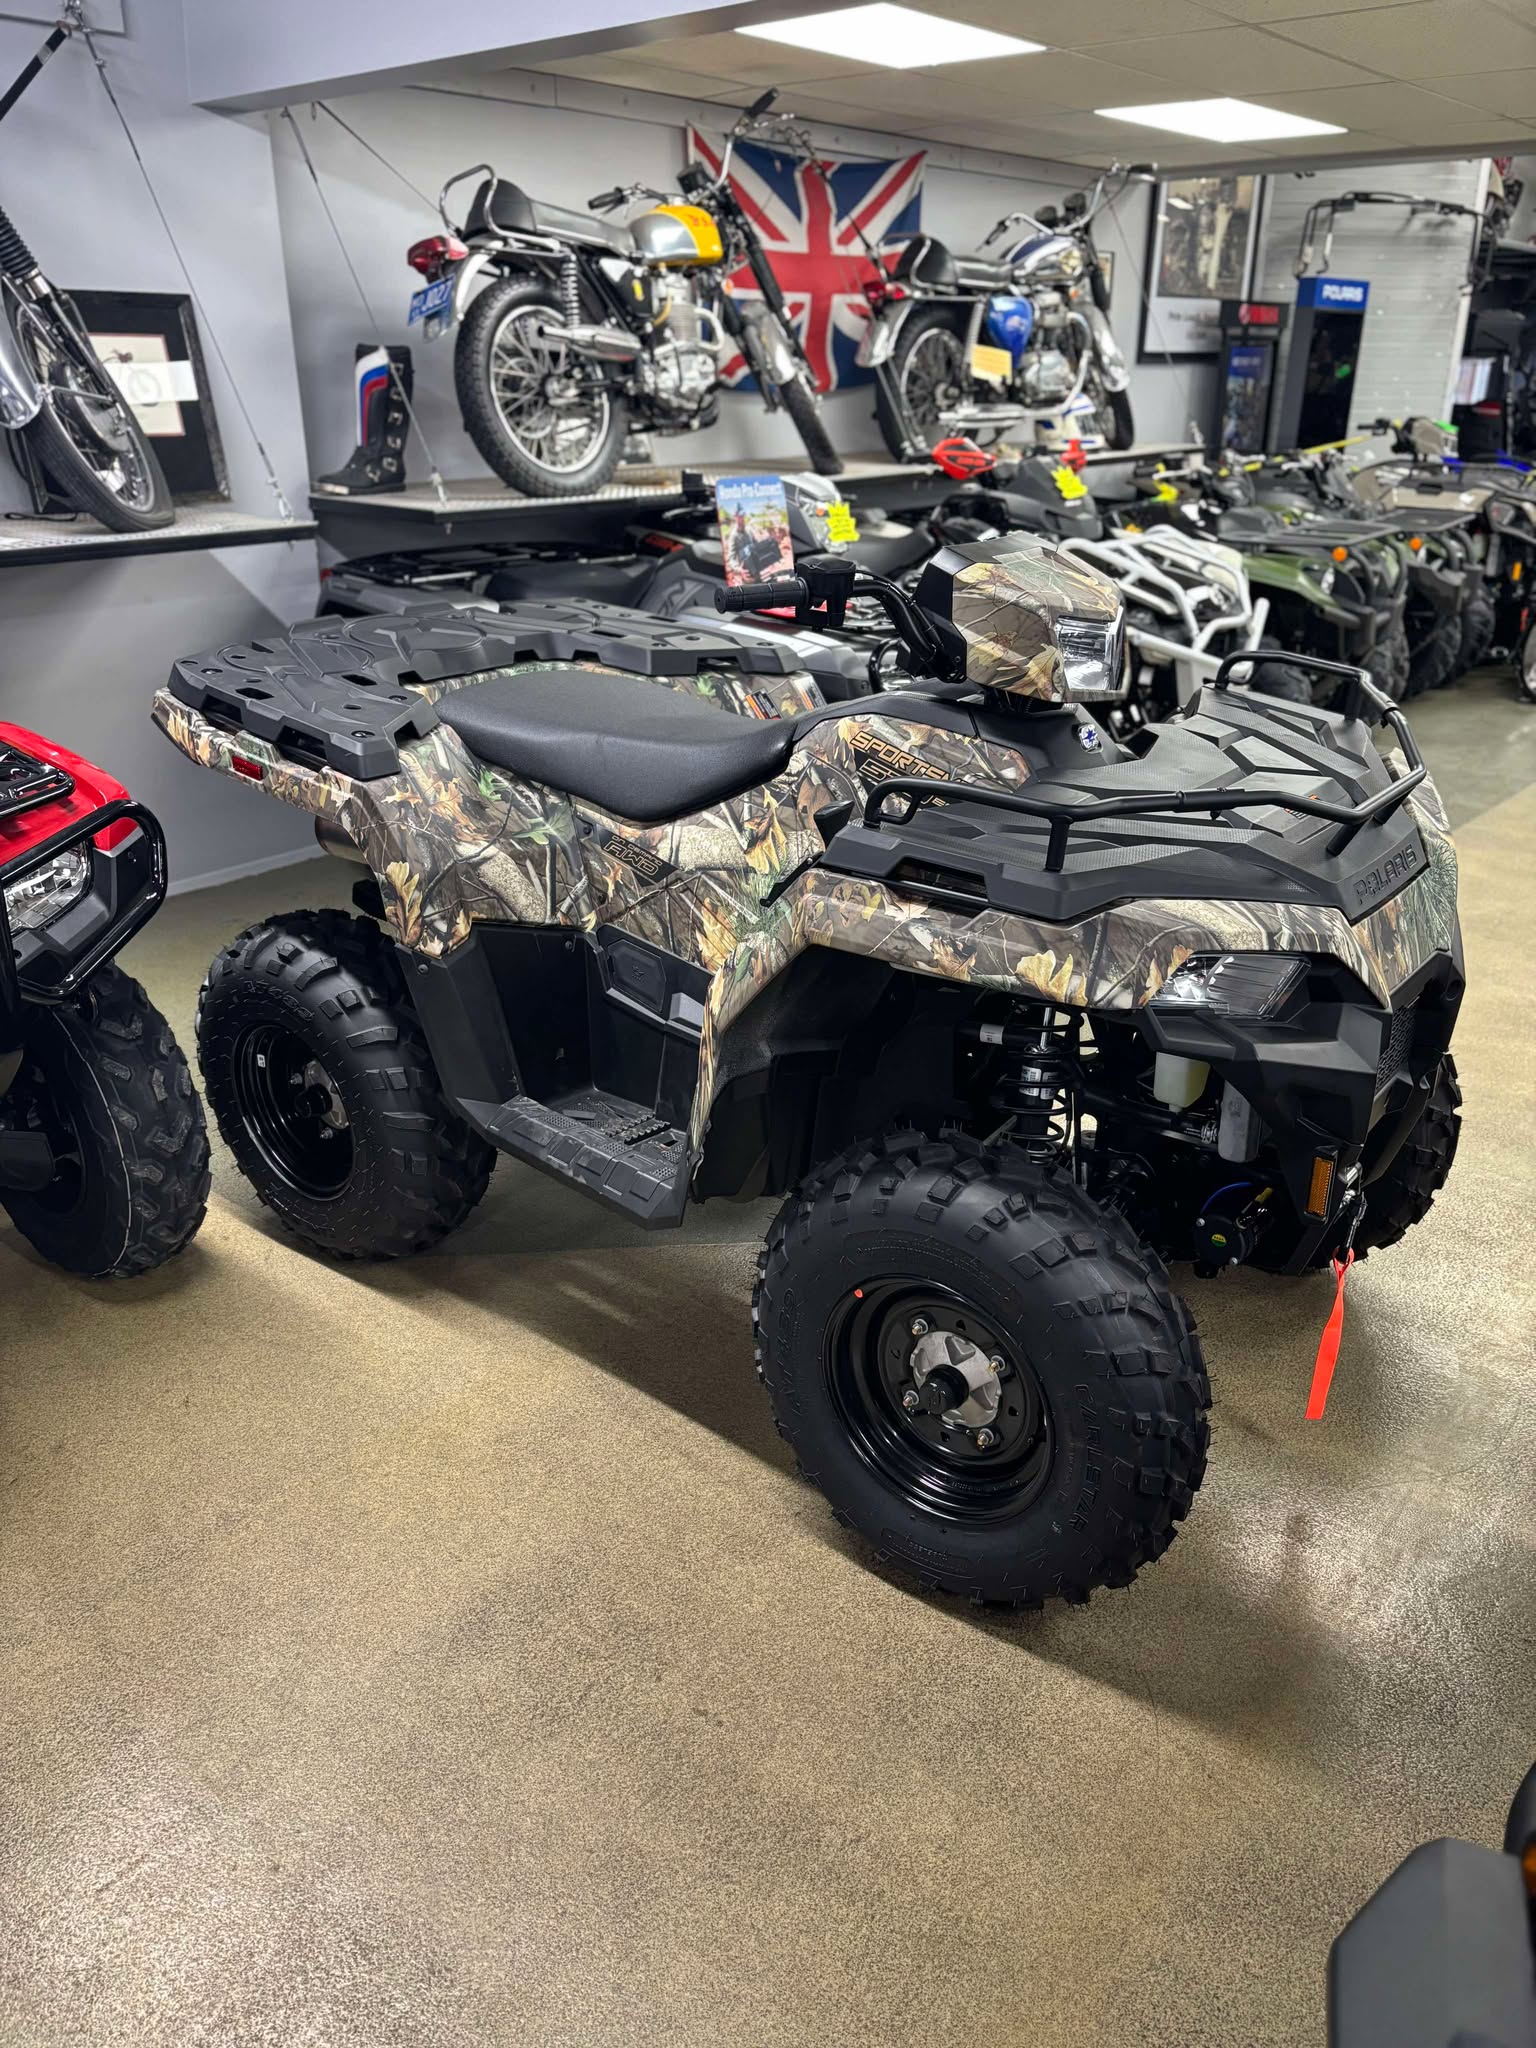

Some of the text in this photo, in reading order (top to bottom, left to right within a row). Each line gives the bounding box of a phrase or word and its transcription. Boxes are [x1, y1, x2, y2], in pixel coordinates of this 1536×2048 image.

[850, 730, 953, 782] SPORTS
[603, 841, 659, 876] AWD
[1353, 844, 1417, 906] POLARIS
